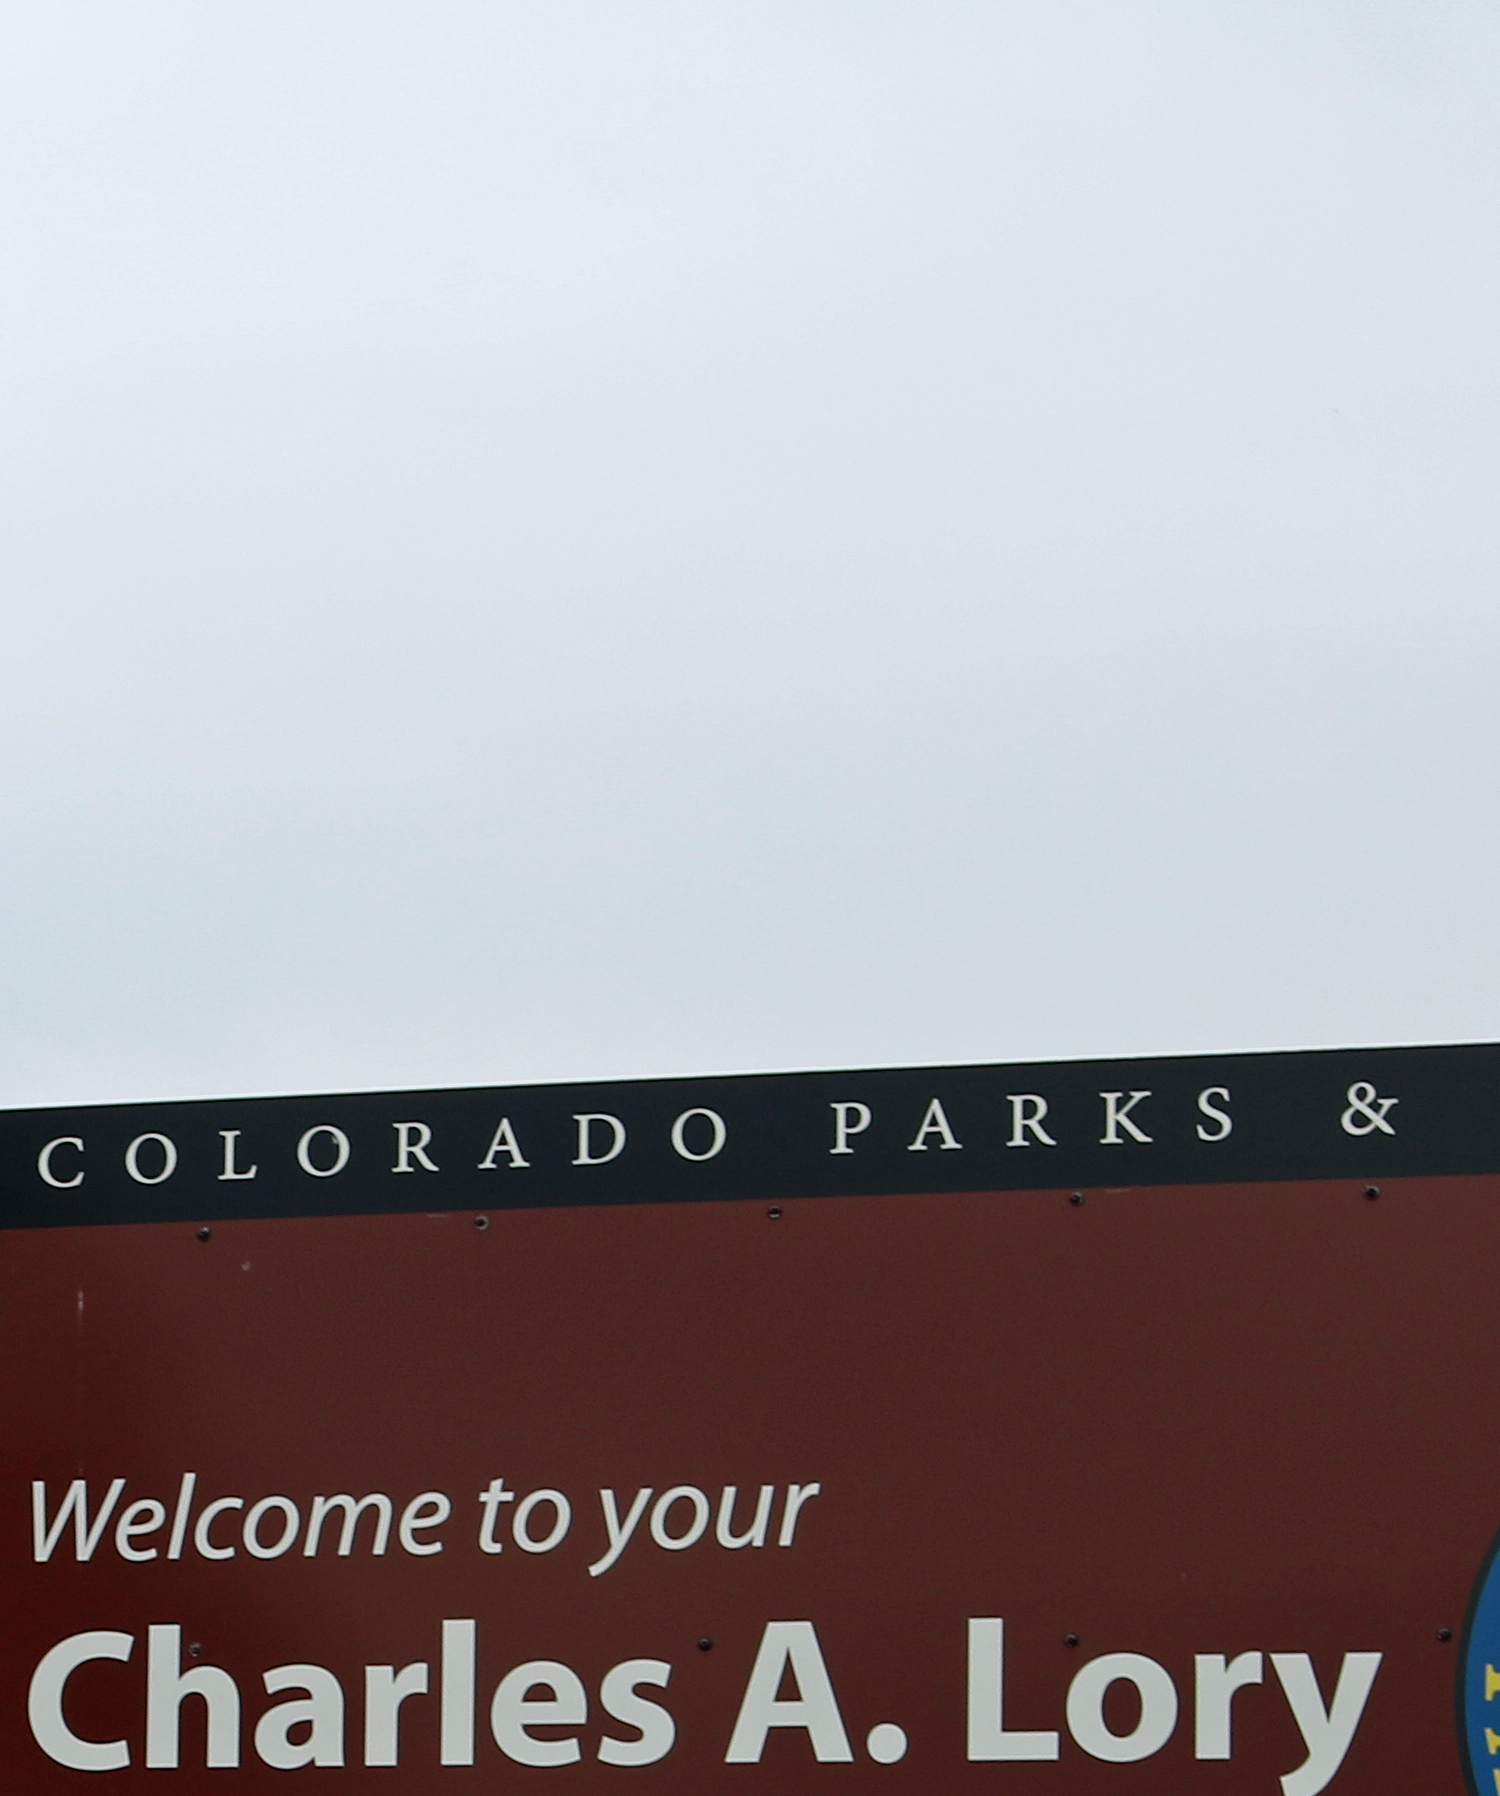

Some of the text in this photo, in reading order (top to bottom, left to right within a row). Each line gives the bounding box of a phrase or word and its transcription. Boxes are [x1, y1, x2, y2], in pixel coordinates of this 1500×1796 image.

[37, 1107, 727, 1189] COLORADO
[828, 1086, 1233, 1155] PARKS
[1340, 1081, 1400, 1137] &
[31, 1472, 822, 1578] Welcome to your
[28, 1618, 676, 1771] Charles
[724, 1620, 907, 1765] A.
